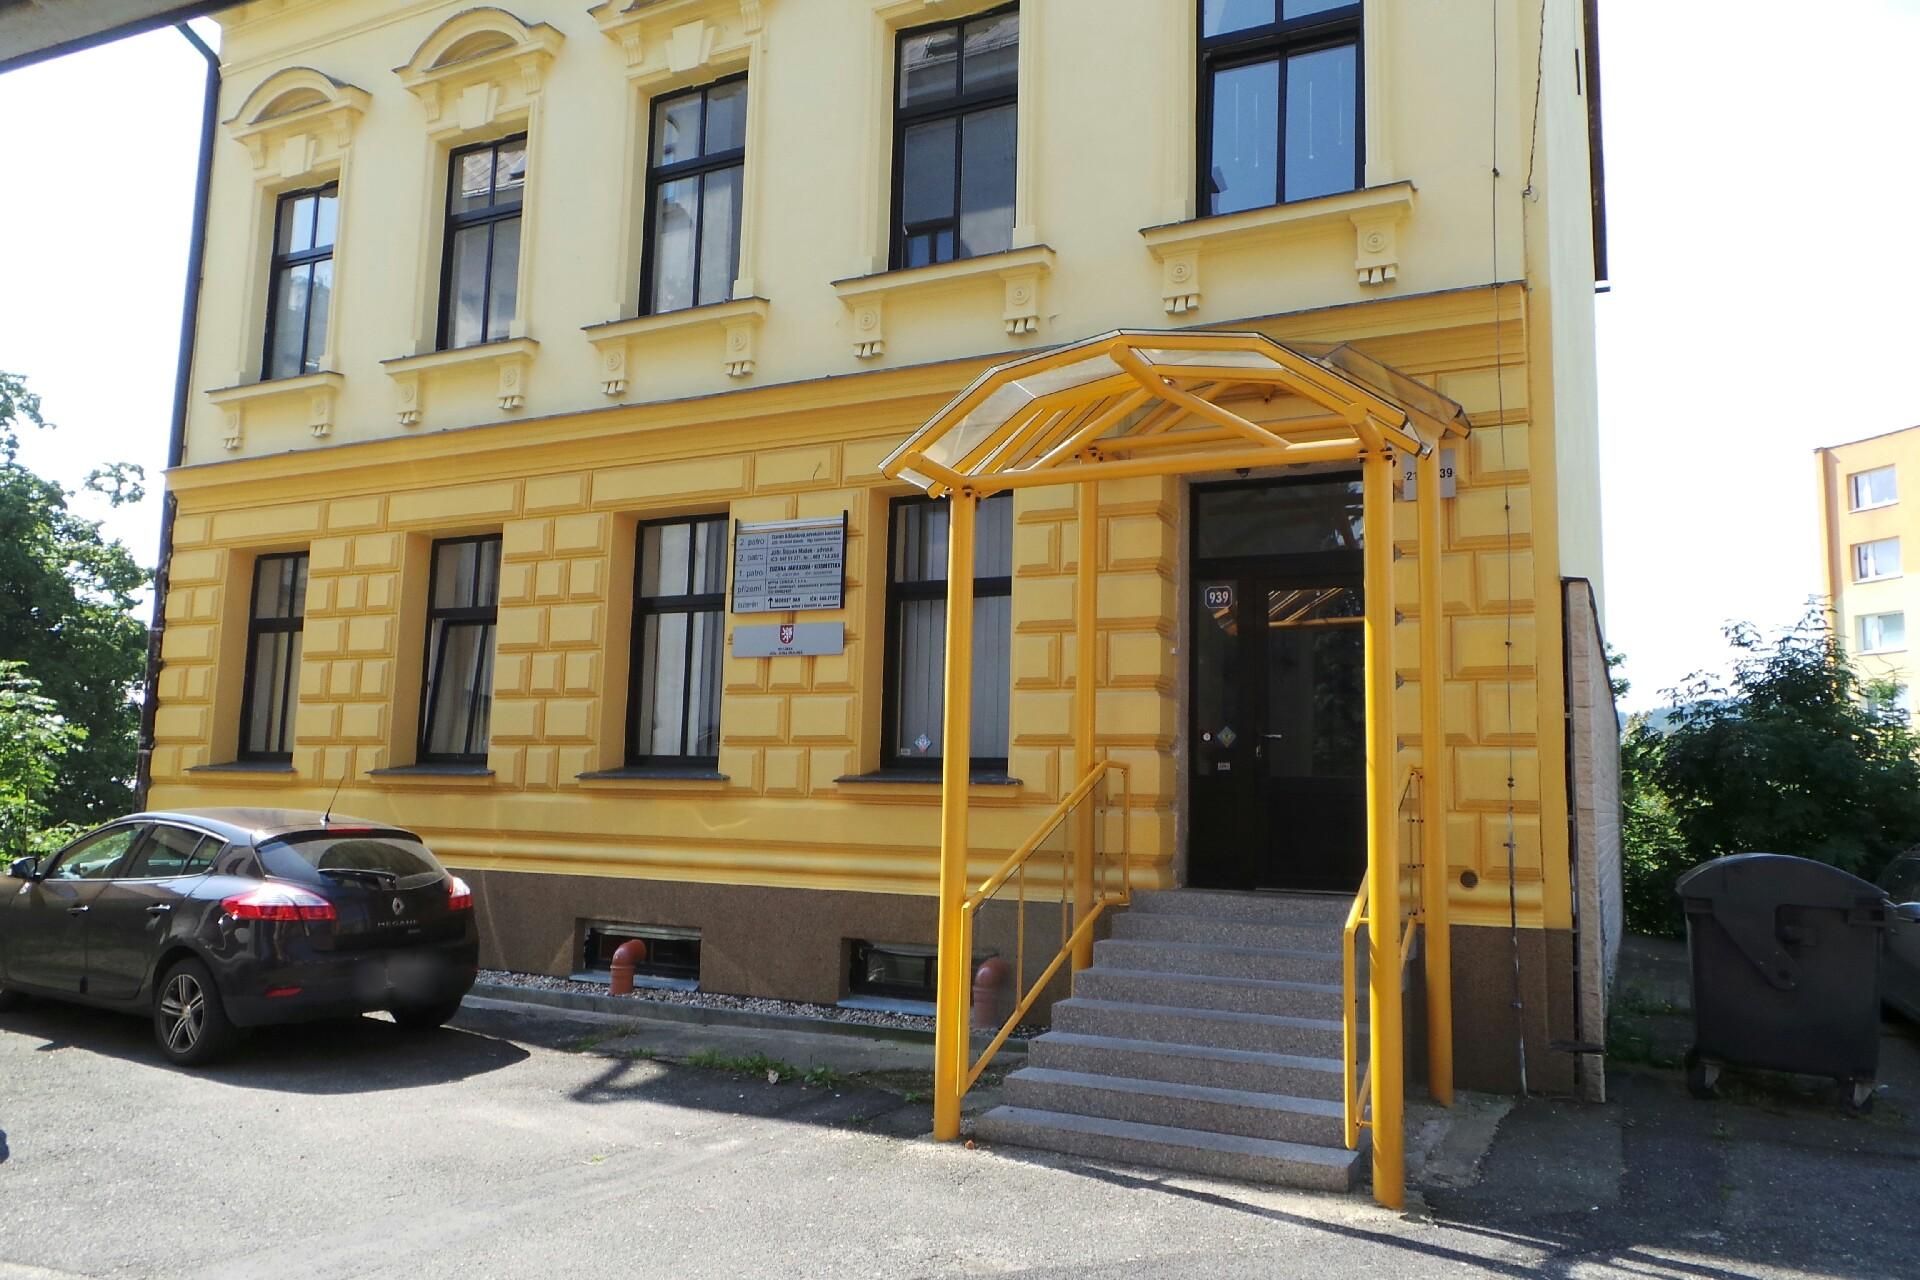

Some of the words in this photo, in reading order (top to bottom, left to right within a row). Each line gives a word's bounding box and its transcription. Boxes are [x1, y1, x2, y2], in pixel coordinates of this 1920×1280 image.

[747, 538, 765, 547] patro
[746, 569, 764, 579] patro
[1209, 591, 1229, 604] 939
